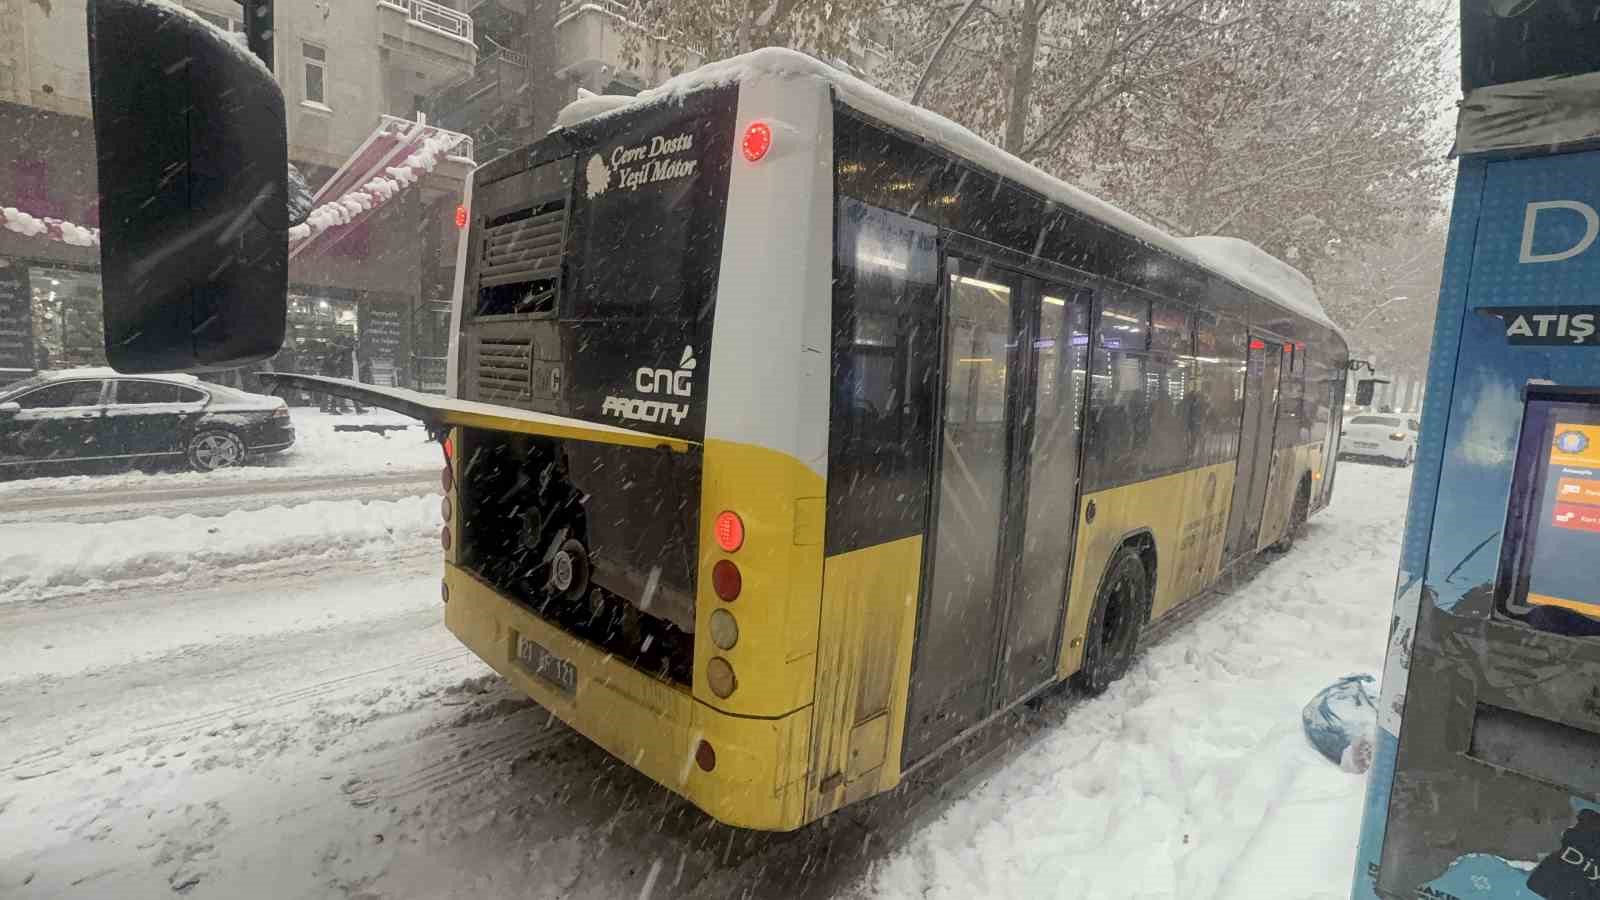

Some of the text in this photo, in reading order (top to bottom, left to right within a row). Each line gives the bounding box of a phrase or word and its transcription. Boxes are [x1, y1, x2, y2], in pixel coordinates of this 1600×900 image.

[610, 132, 693, 171] Çevre Dostu
[618, 159, 697, 191] Yeşil Motor
